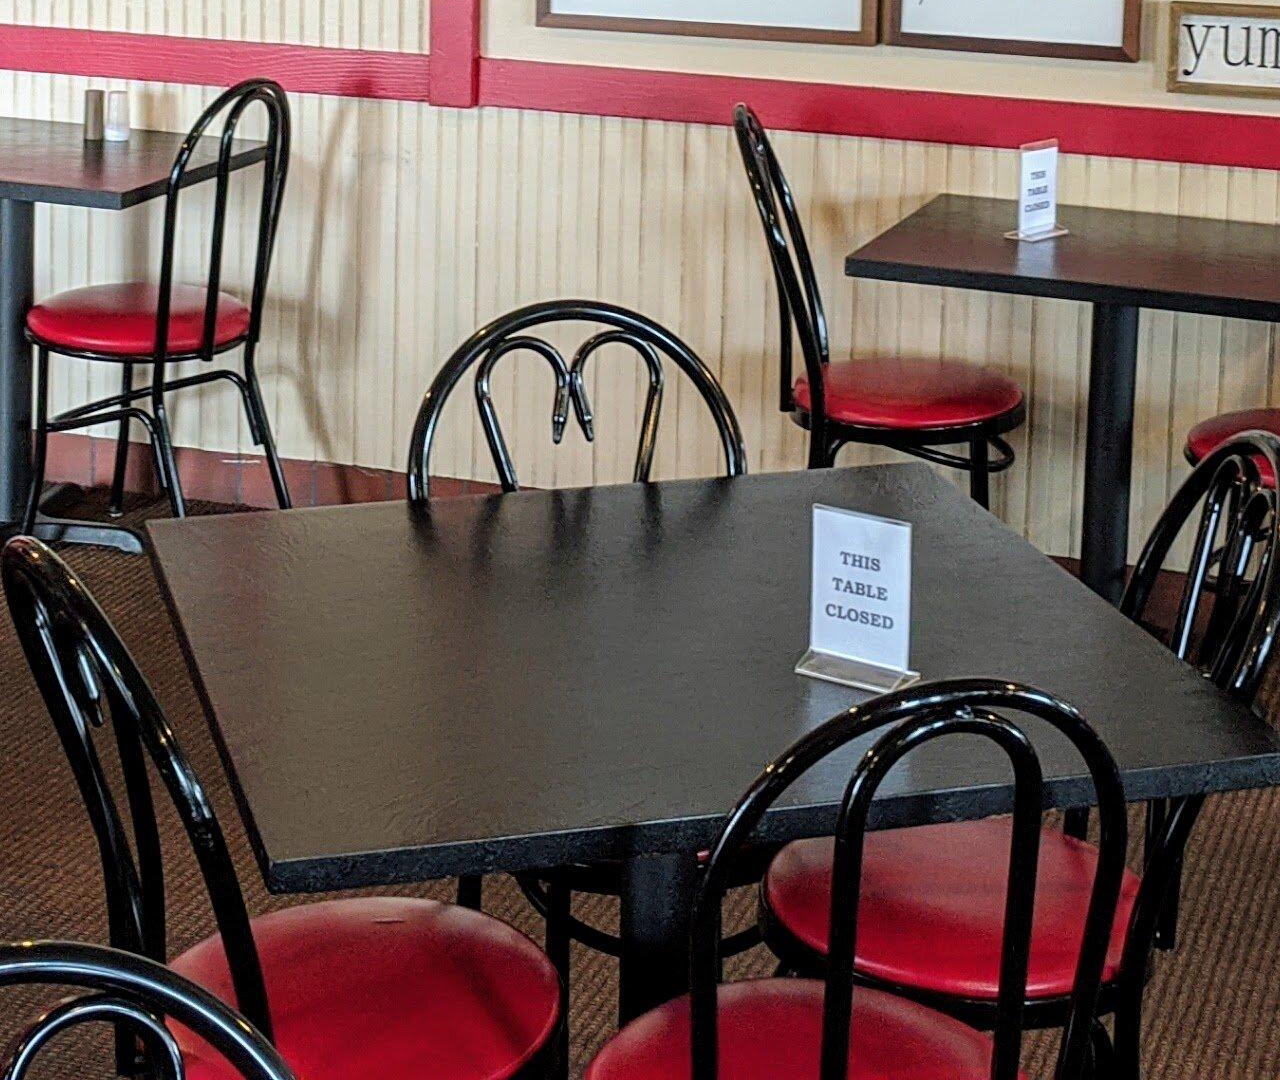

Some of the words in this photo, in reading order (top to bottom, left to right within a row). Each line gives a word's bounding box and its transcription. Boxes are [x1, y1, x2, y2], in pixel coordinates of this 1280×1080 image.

[839, 550, 882, 572] THIS
[831, 576, 889, 602] TABLE
[824, 602, 895, 630] CLOSED
